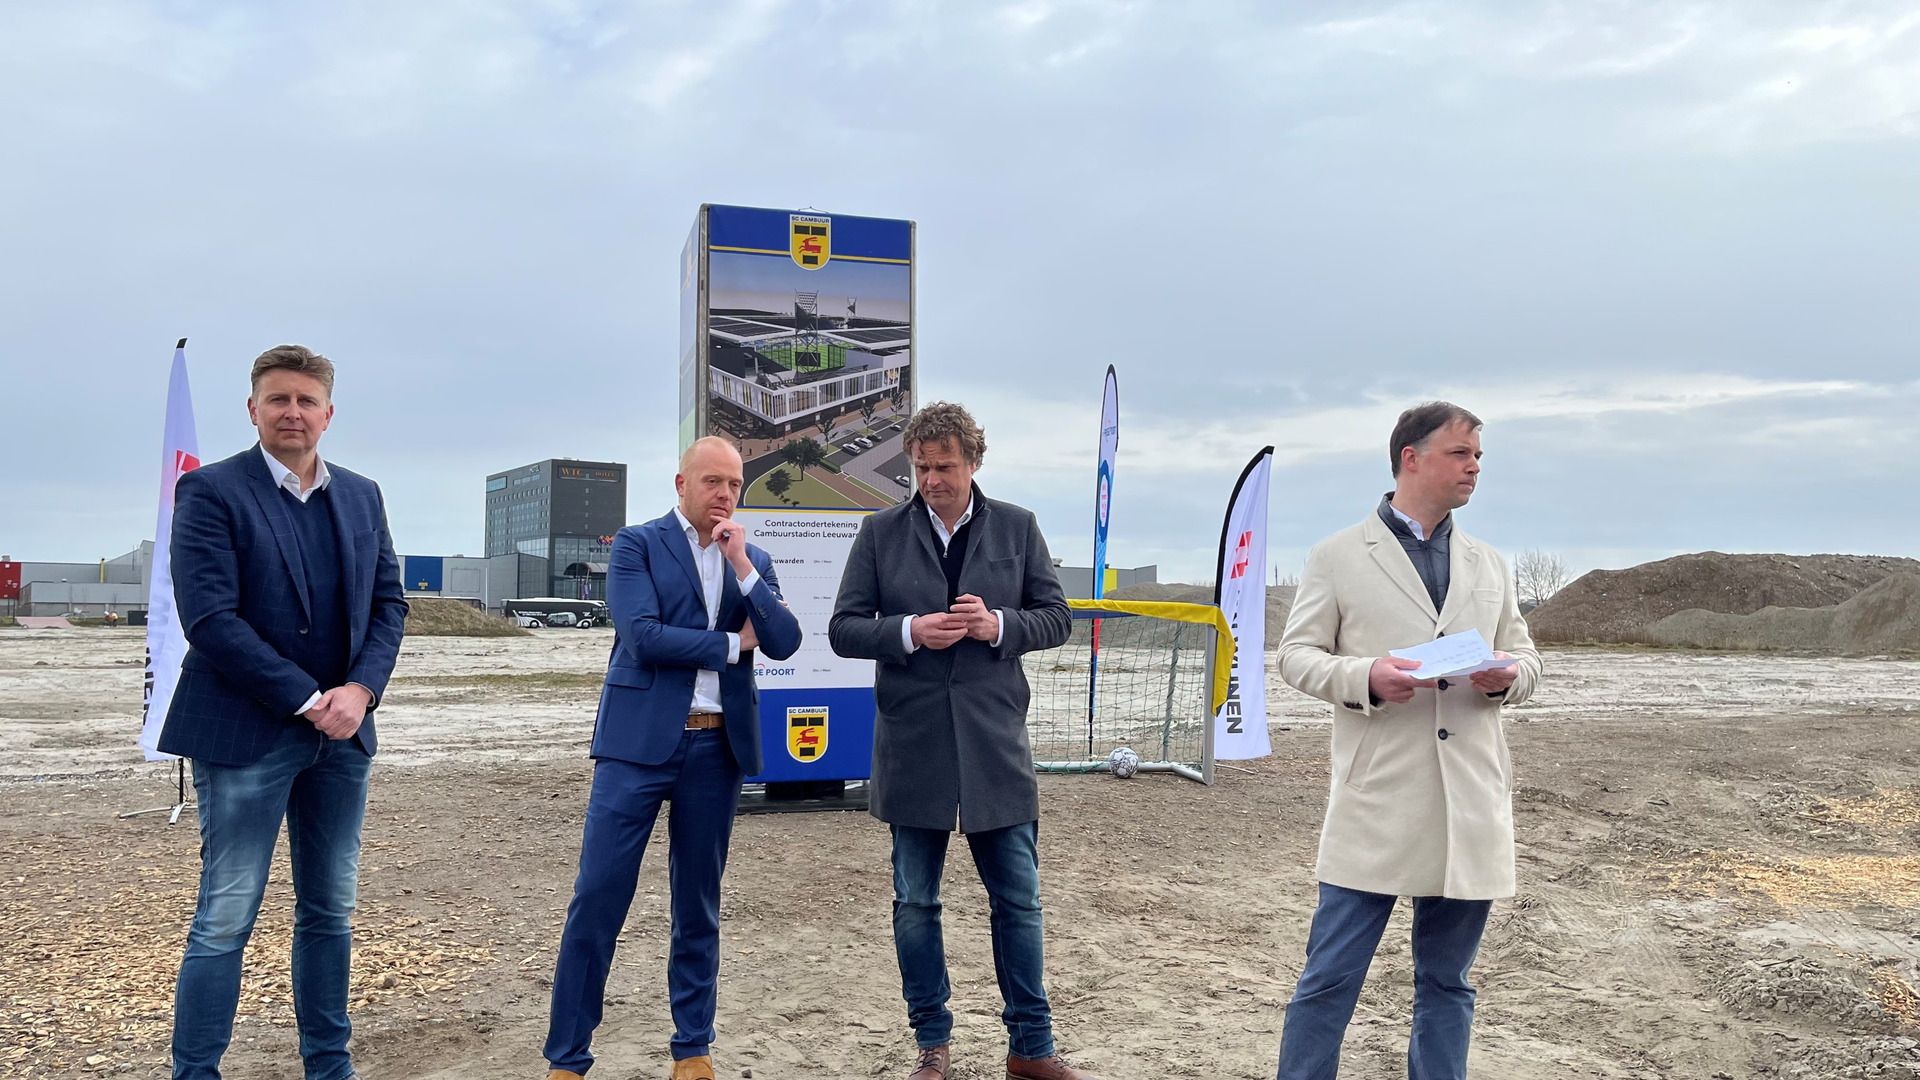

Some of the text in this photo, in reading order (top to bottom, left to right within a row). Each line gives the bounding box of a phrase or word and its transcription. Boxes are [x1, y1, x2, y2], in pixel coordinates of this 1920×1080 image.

[764, 519, 858, 530] Contractondertekening
[754, 529, 821, 539] Cambuurstadion
[765, 668, 796, 676] POORT
